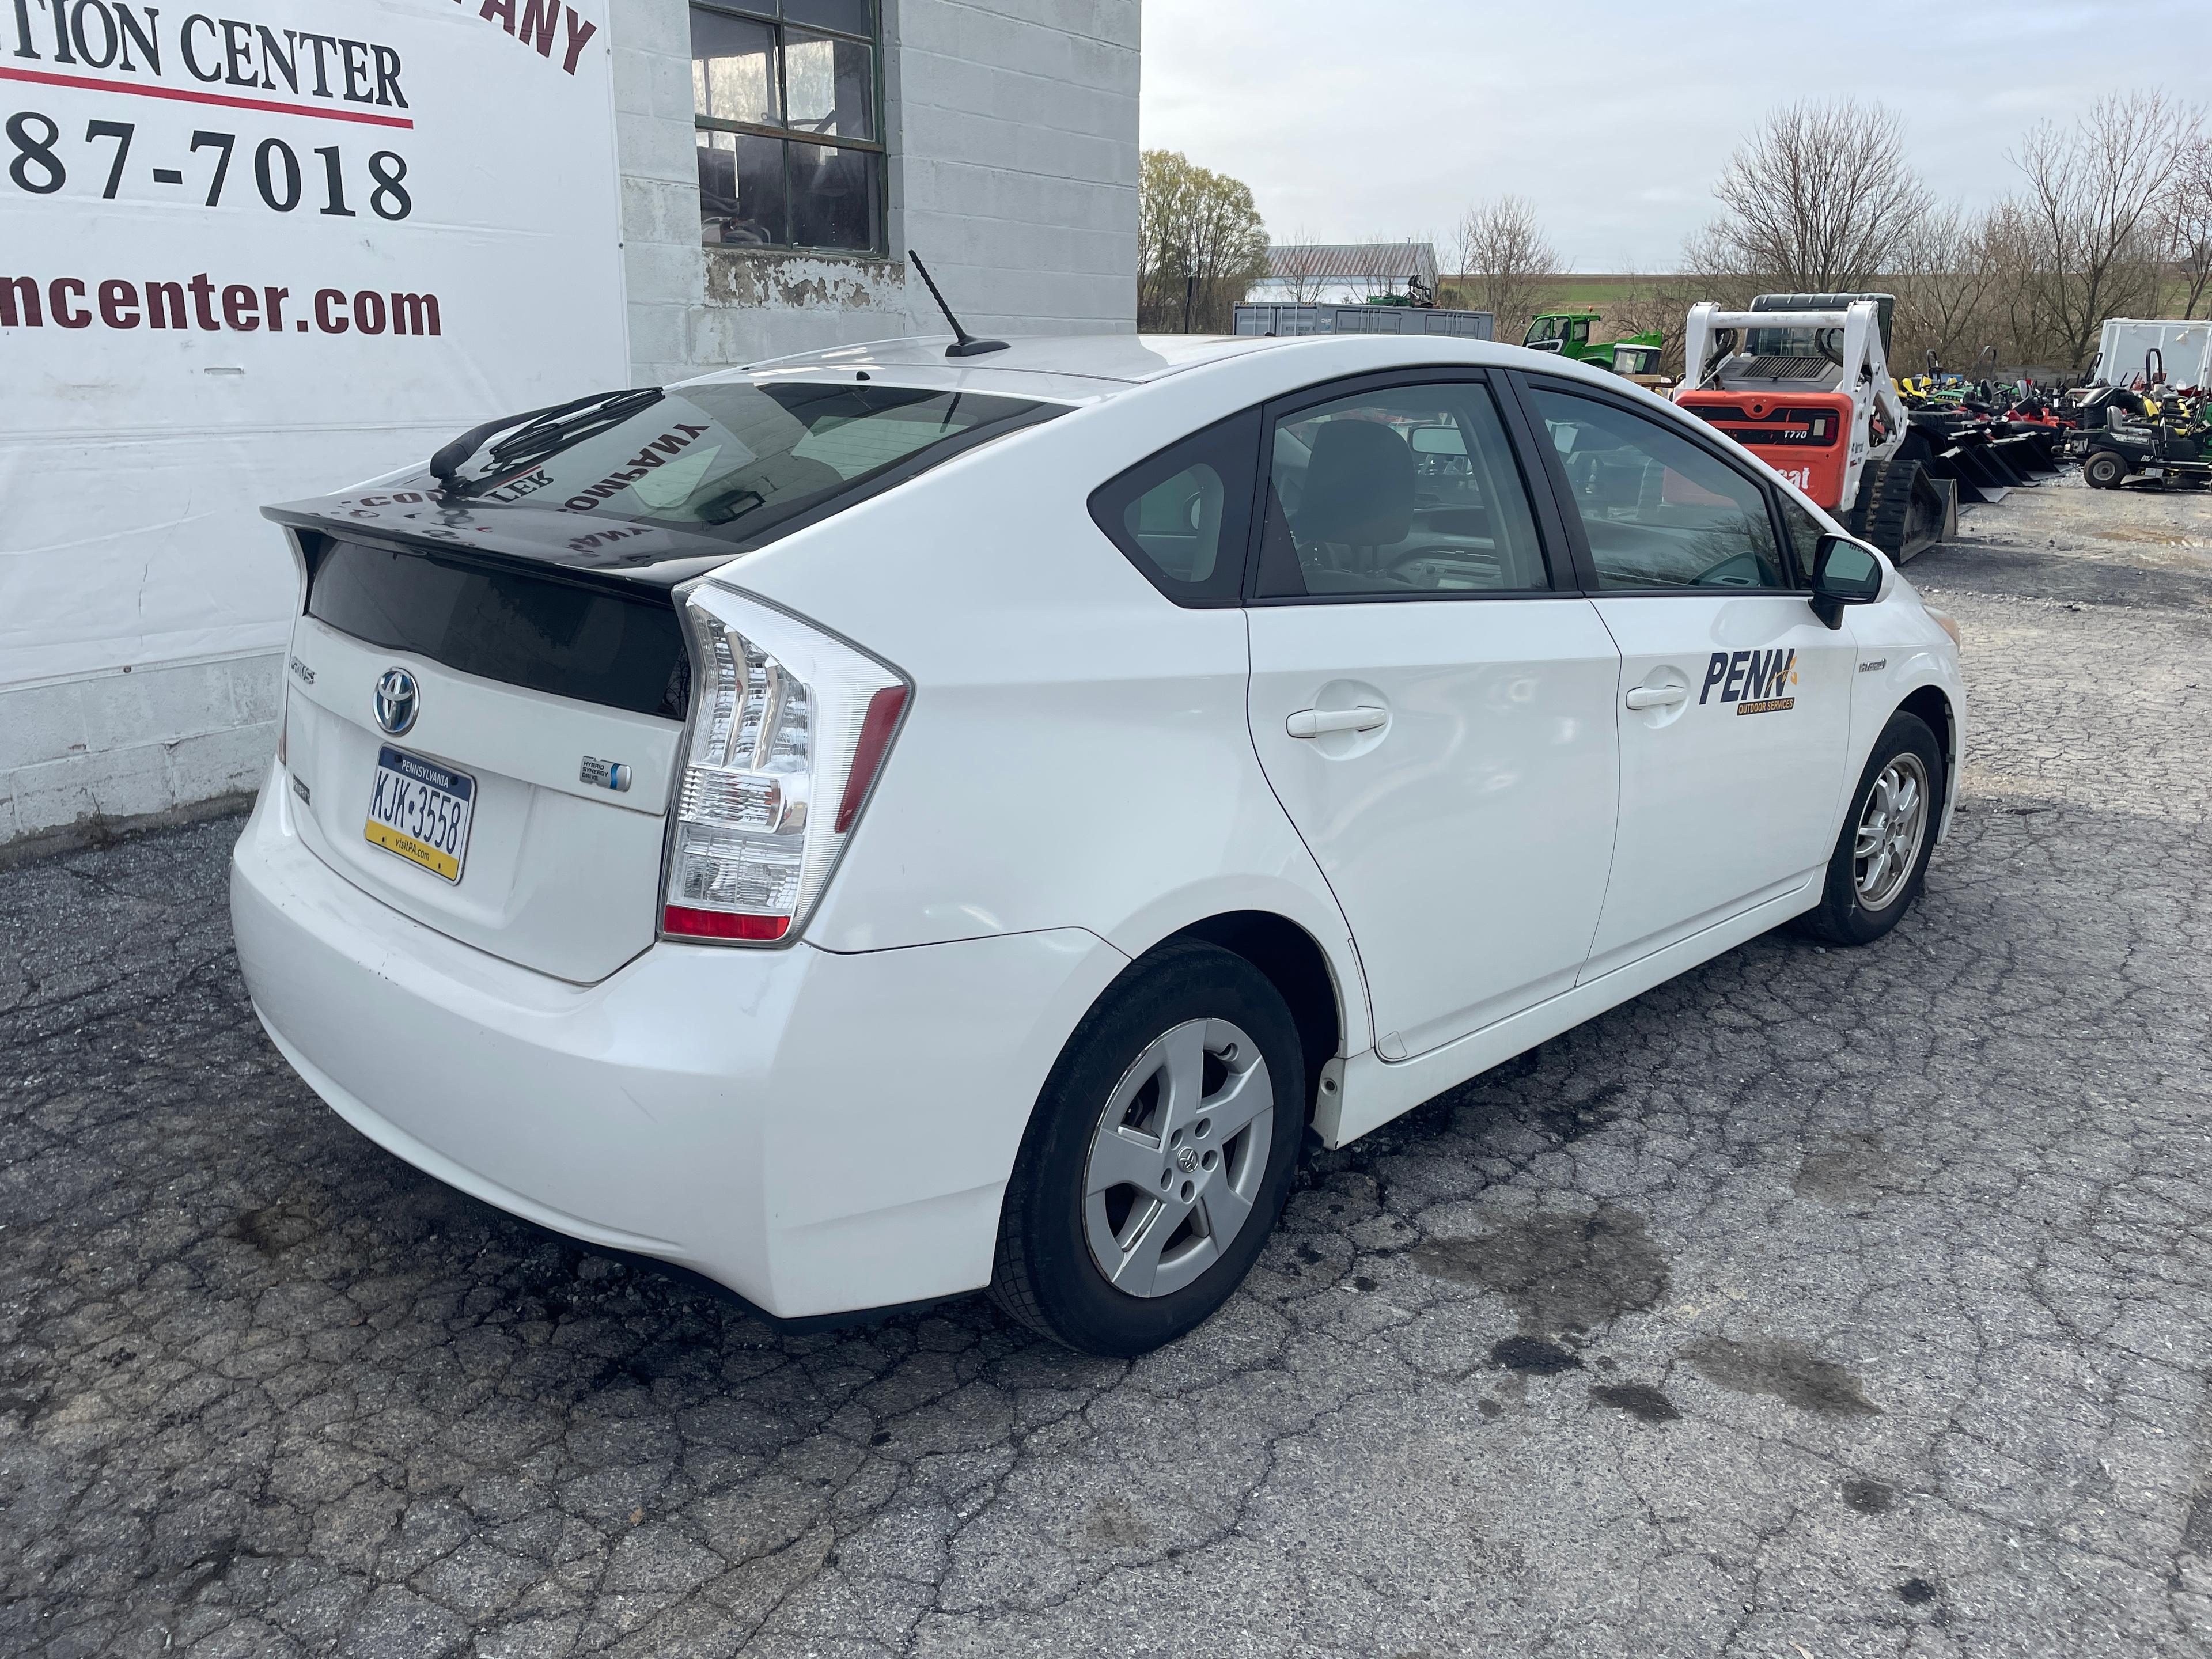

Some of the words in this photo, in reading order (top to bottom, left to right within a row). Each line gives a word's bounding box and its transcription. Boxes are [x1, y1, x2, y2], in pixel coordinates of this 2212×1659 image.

[180, 14, 409, 109] CENTER
[5, 111, 412, 221] 87-7018
[0, 272, 442, 336] ncenter.com
[1784, 430, 1808, 438] T770
[1699, 648, 1796, 705] PENN
[1738, 703, 1767, 714] OUTDOOR
[1767, 699, 1793, 710] SERVICES
[401, 759, 449, 789] PENNSYLVANIA
[581, 772, 599, 781] DRIVE
[582, 767, 609, 777] SYNERGY
[584, 761, 604, 770] HYBRID
[395, 837, 430, 861] visitPA.com
